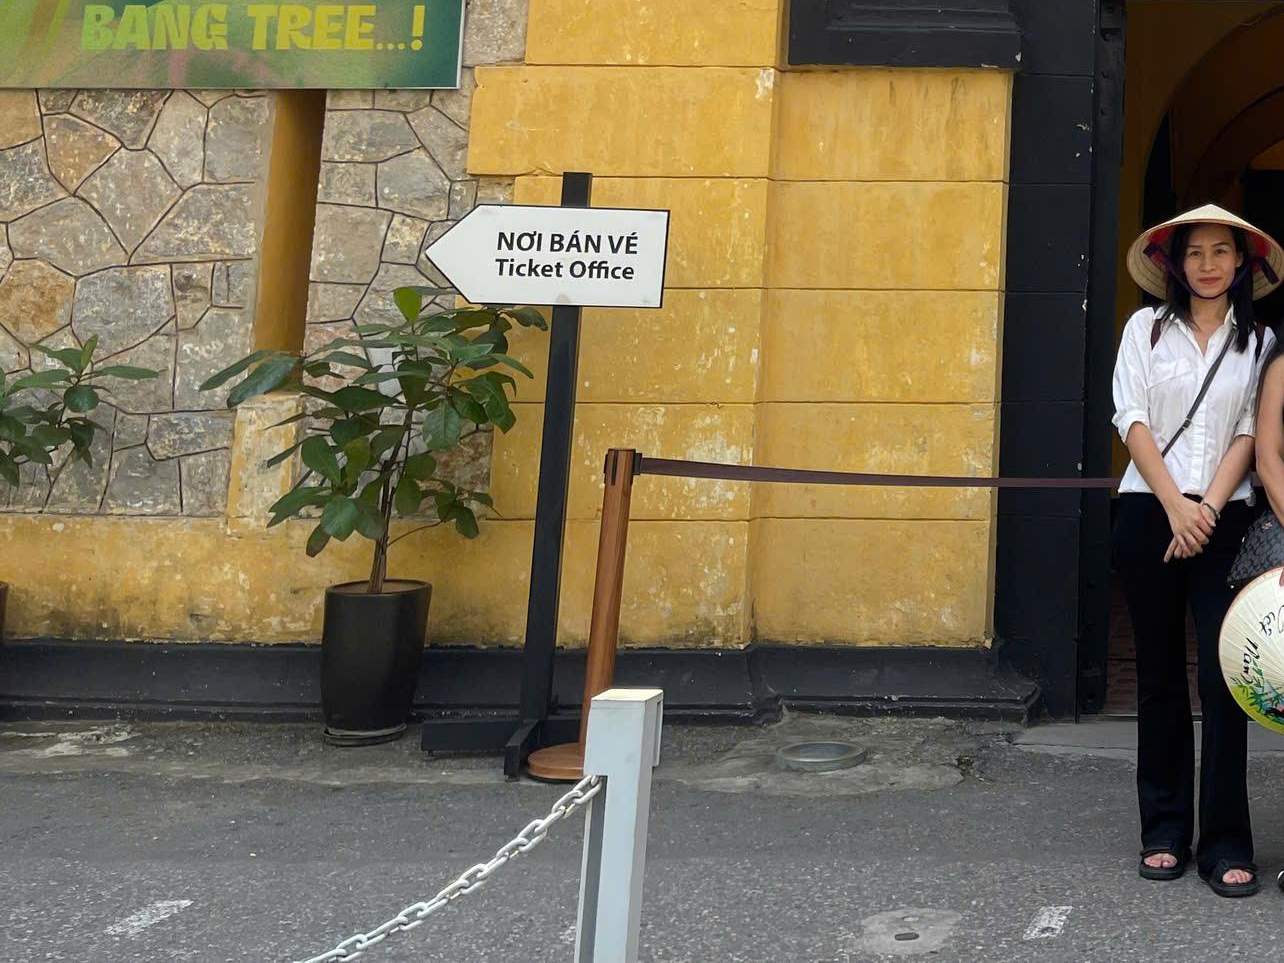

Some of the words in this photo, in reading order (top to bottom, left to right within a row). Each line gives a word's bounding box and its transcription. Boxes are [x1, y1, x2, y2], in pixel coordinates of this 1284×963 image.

[81, 4, 229, 51] BANG
[247, 4, 426, 51] TREE...!
[497, 231, 543, 252] NƠI
[550, 230, 601, 254] BÁN
[608, 232, 639, 255] VÉ
[495, 258, 564, 278] Ticket
[569, 260, 635, 280] Office
